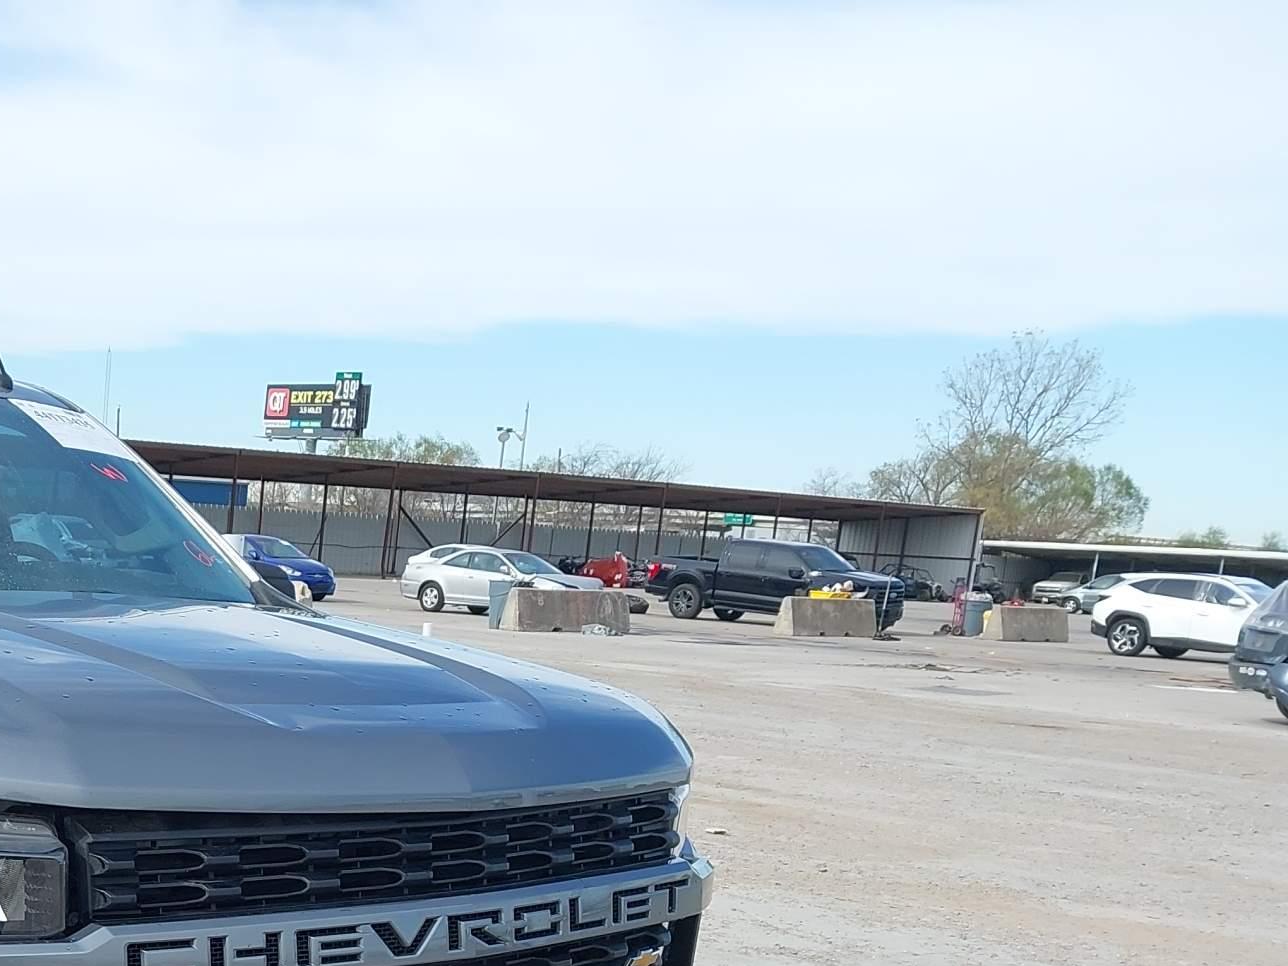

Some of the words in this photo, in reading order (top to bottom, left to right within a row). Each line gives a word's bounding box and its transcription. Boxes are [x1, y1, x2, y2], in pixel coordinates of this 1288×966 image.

[269, 391, 285, 413] QT
[291, 391, 313, 403] EXIT
[314, 391, 333, 403] 273
